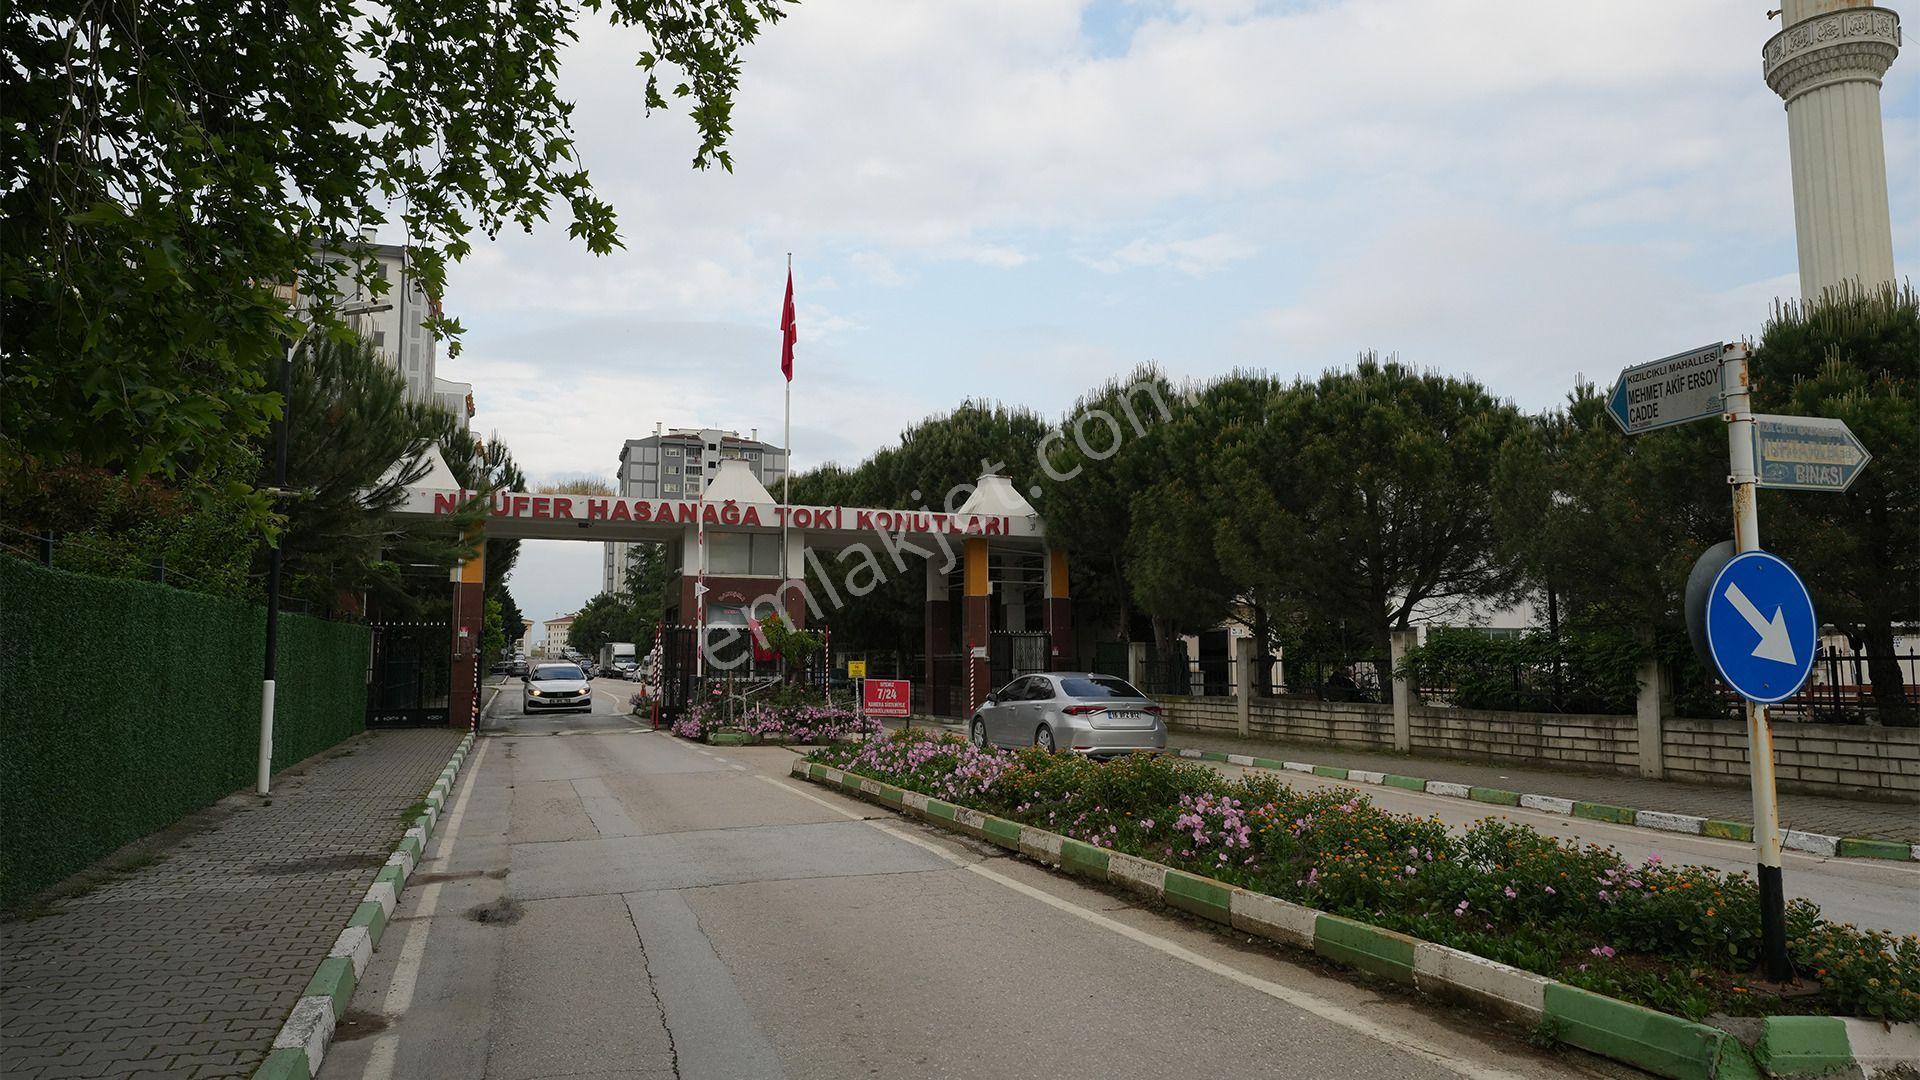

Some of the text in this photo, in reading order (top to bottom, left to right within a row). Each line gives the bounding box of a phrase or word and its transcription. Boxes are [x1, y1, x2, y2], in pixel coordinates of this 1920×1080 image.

[1627, 350, 1718, 384] KIZILCIKLI MAHALLESİ
[1628, 367, 1719, 405] MEHMET AKİF ERSOY
[1629, 402, 1659, 423] CADDE
[588, 498, 761, 527] HASANAĞA
[775, 505, 842, 530] TOKİ
[857, 510, 1009, 536] KONUTLARI
[876, 688, 897, 700] 7/24
